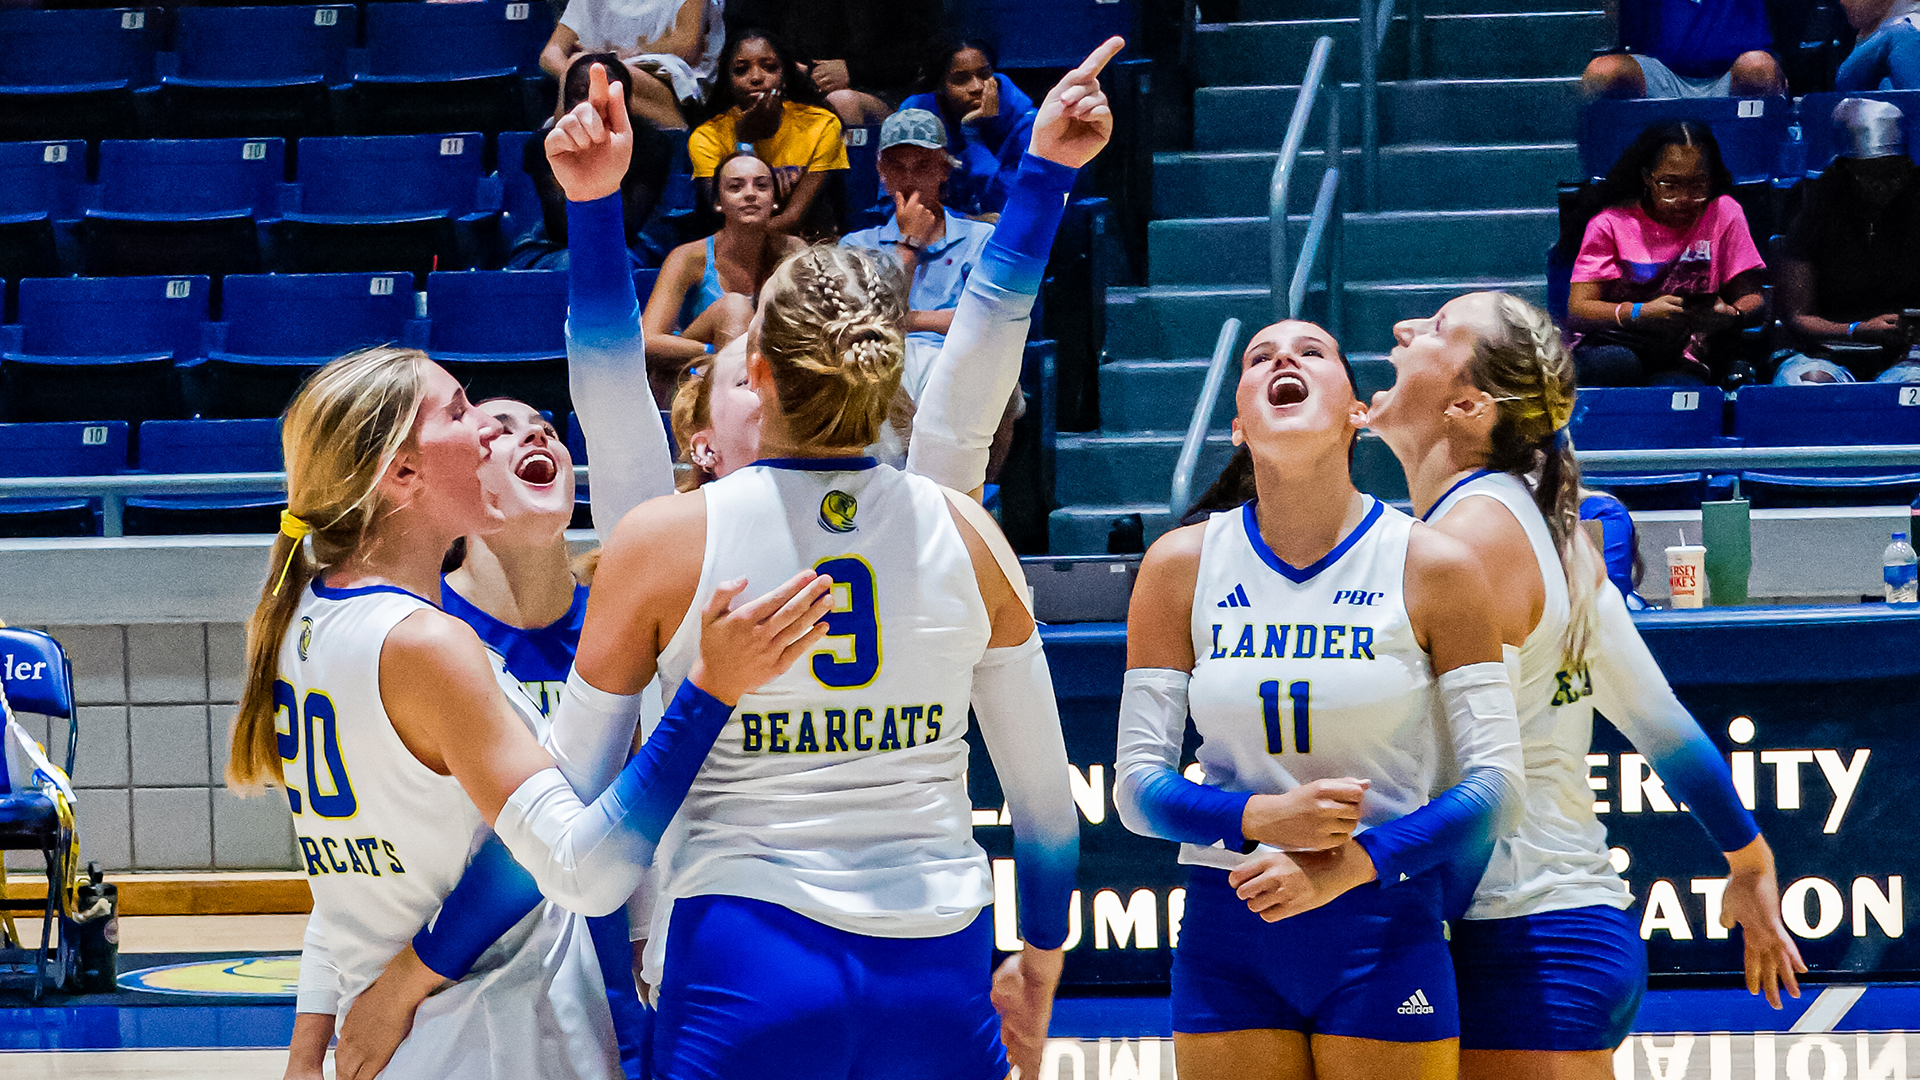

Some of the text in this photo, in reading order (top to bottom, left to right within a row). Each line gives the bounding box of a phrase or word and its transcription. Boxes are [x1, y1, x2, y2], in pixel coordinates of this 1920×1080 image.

[1332, 590, 1384, 606] PBC
[809, 553, 883, 690] 9
[1209, 623, 1376, 660] LANDER
[741, 704, 944, 753] BEARCATS
[1257, 678, 1312, 755] 11
[1397, 1003, 1434, 1015] adidas
